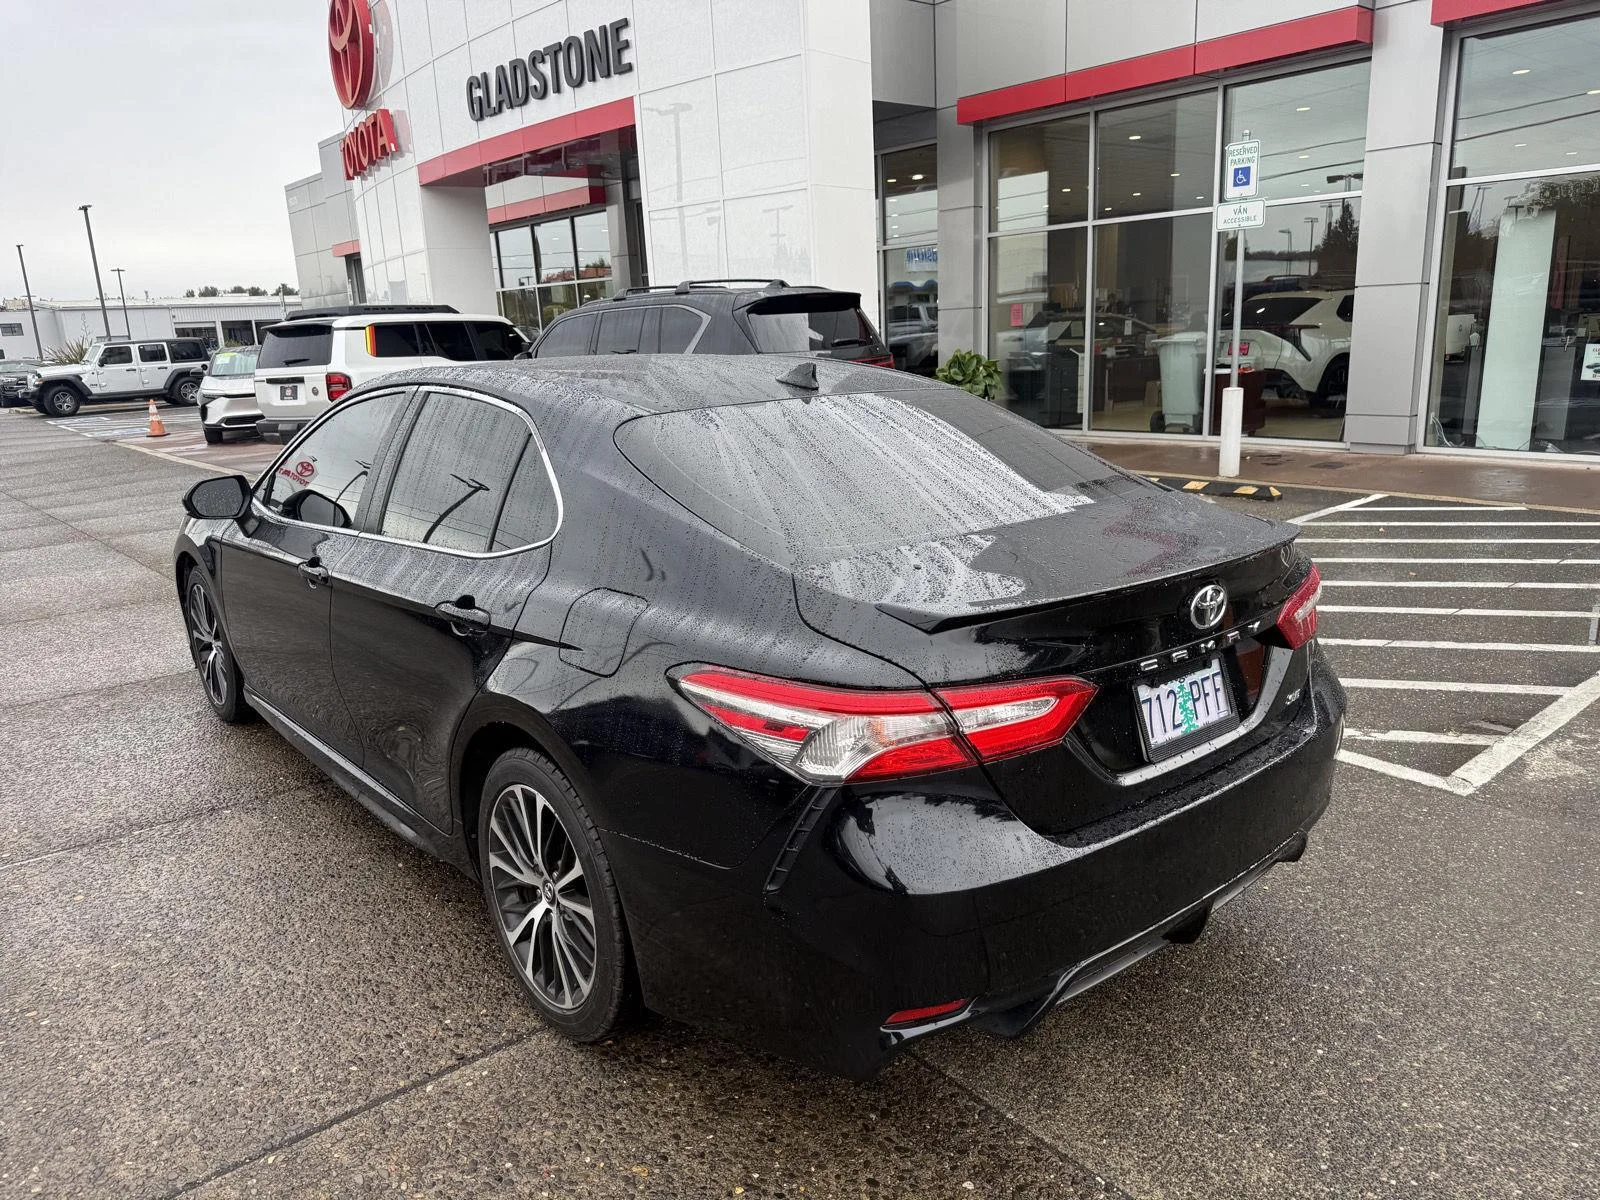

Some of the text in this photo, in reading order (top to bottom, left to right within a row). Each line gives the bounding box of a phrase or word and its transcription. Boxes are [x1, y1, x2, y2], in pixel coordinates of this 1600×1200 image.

[466, 18, 633, 122] GLADSTONE
[1228, 146, 1257, 157] RESERVED
[1230, 156, 1255, 166] PARKING
[1233, 207, 1248, 215] VAN
[1223, 215, 1257, 224] ACCESSIBLE
[1141, 671, 1222, 739] 712 PFF
